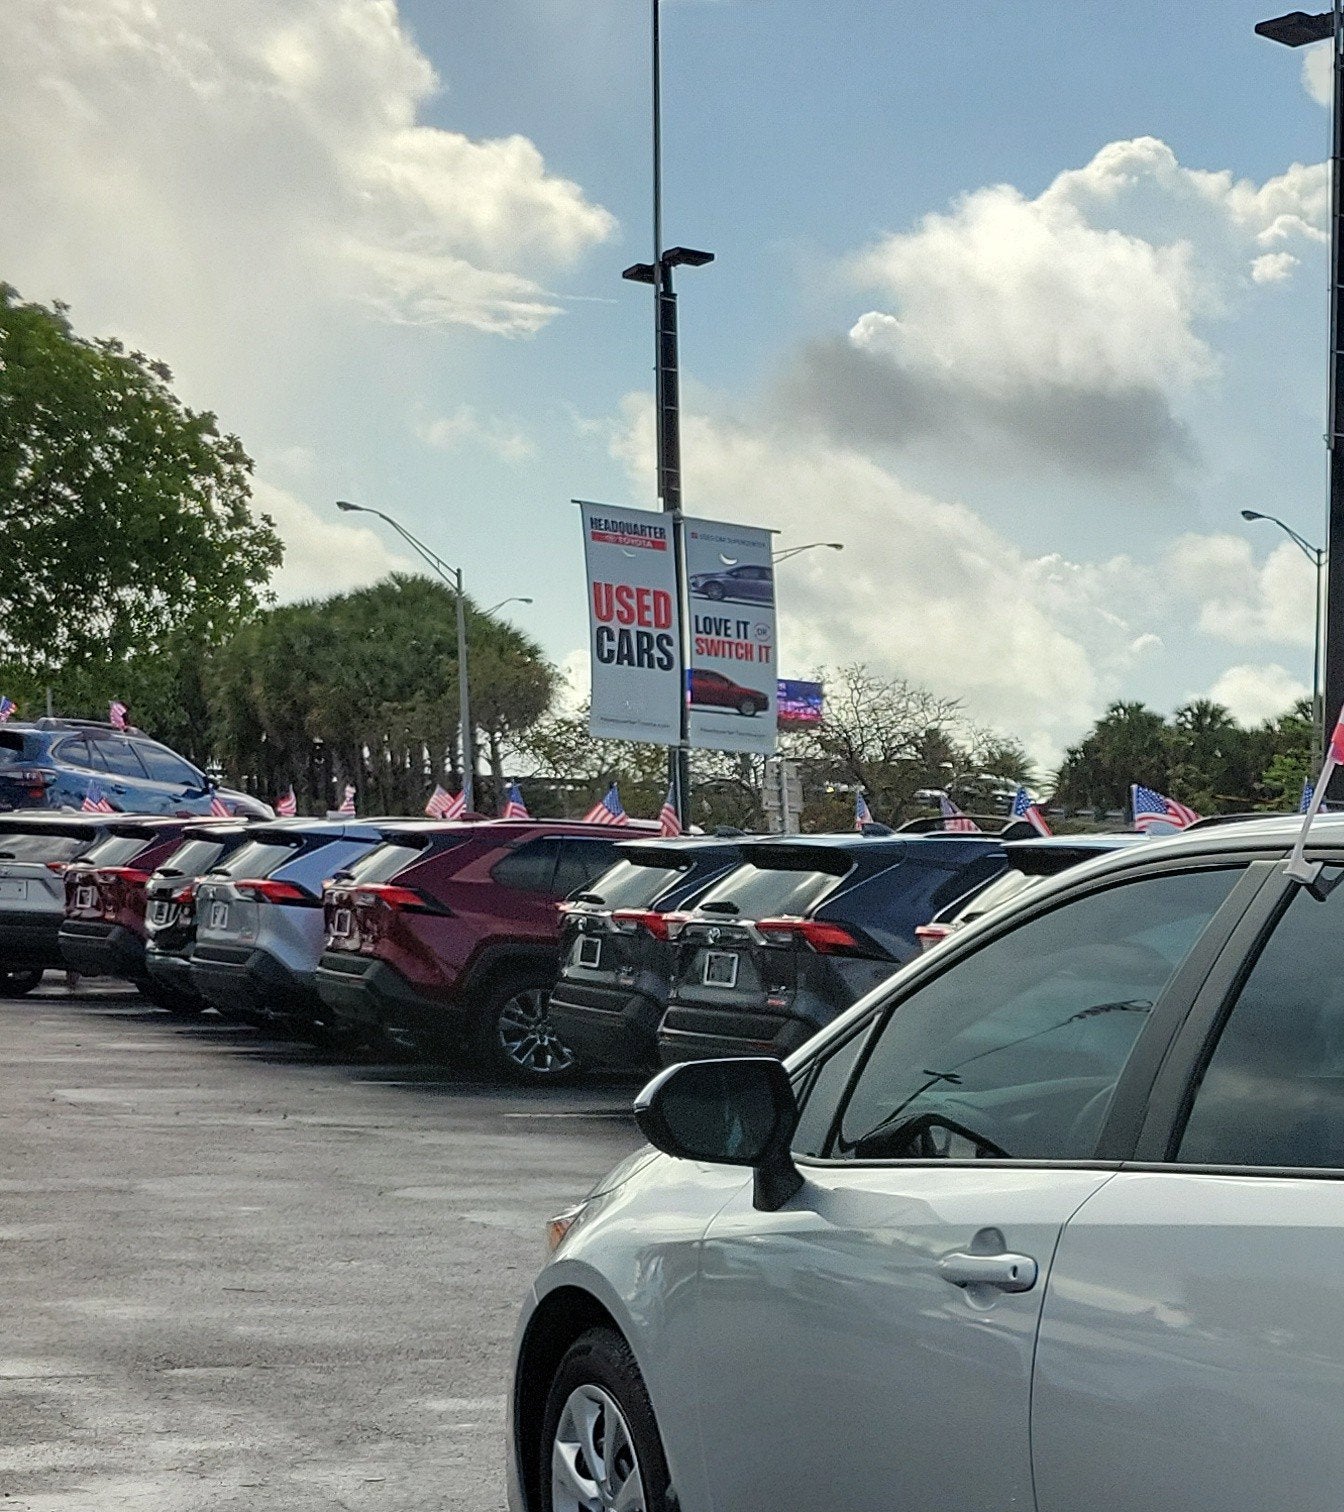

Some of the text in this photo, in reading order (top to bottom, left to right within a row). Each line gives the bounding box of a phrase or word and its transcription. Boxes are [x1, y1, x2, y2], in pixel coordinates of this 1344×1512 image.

[590, 517, 666, 540] HEADQUARTER
[618, 537, 653, 549] TOYOTA
[593, 582, 672, 629] USED
[695, 615, 732, 637] LOVE
[736, 620, 750, 639] IT
[596, 626, 674, 671] CARS
[695, 637, 772, 663] SWITCH IT
